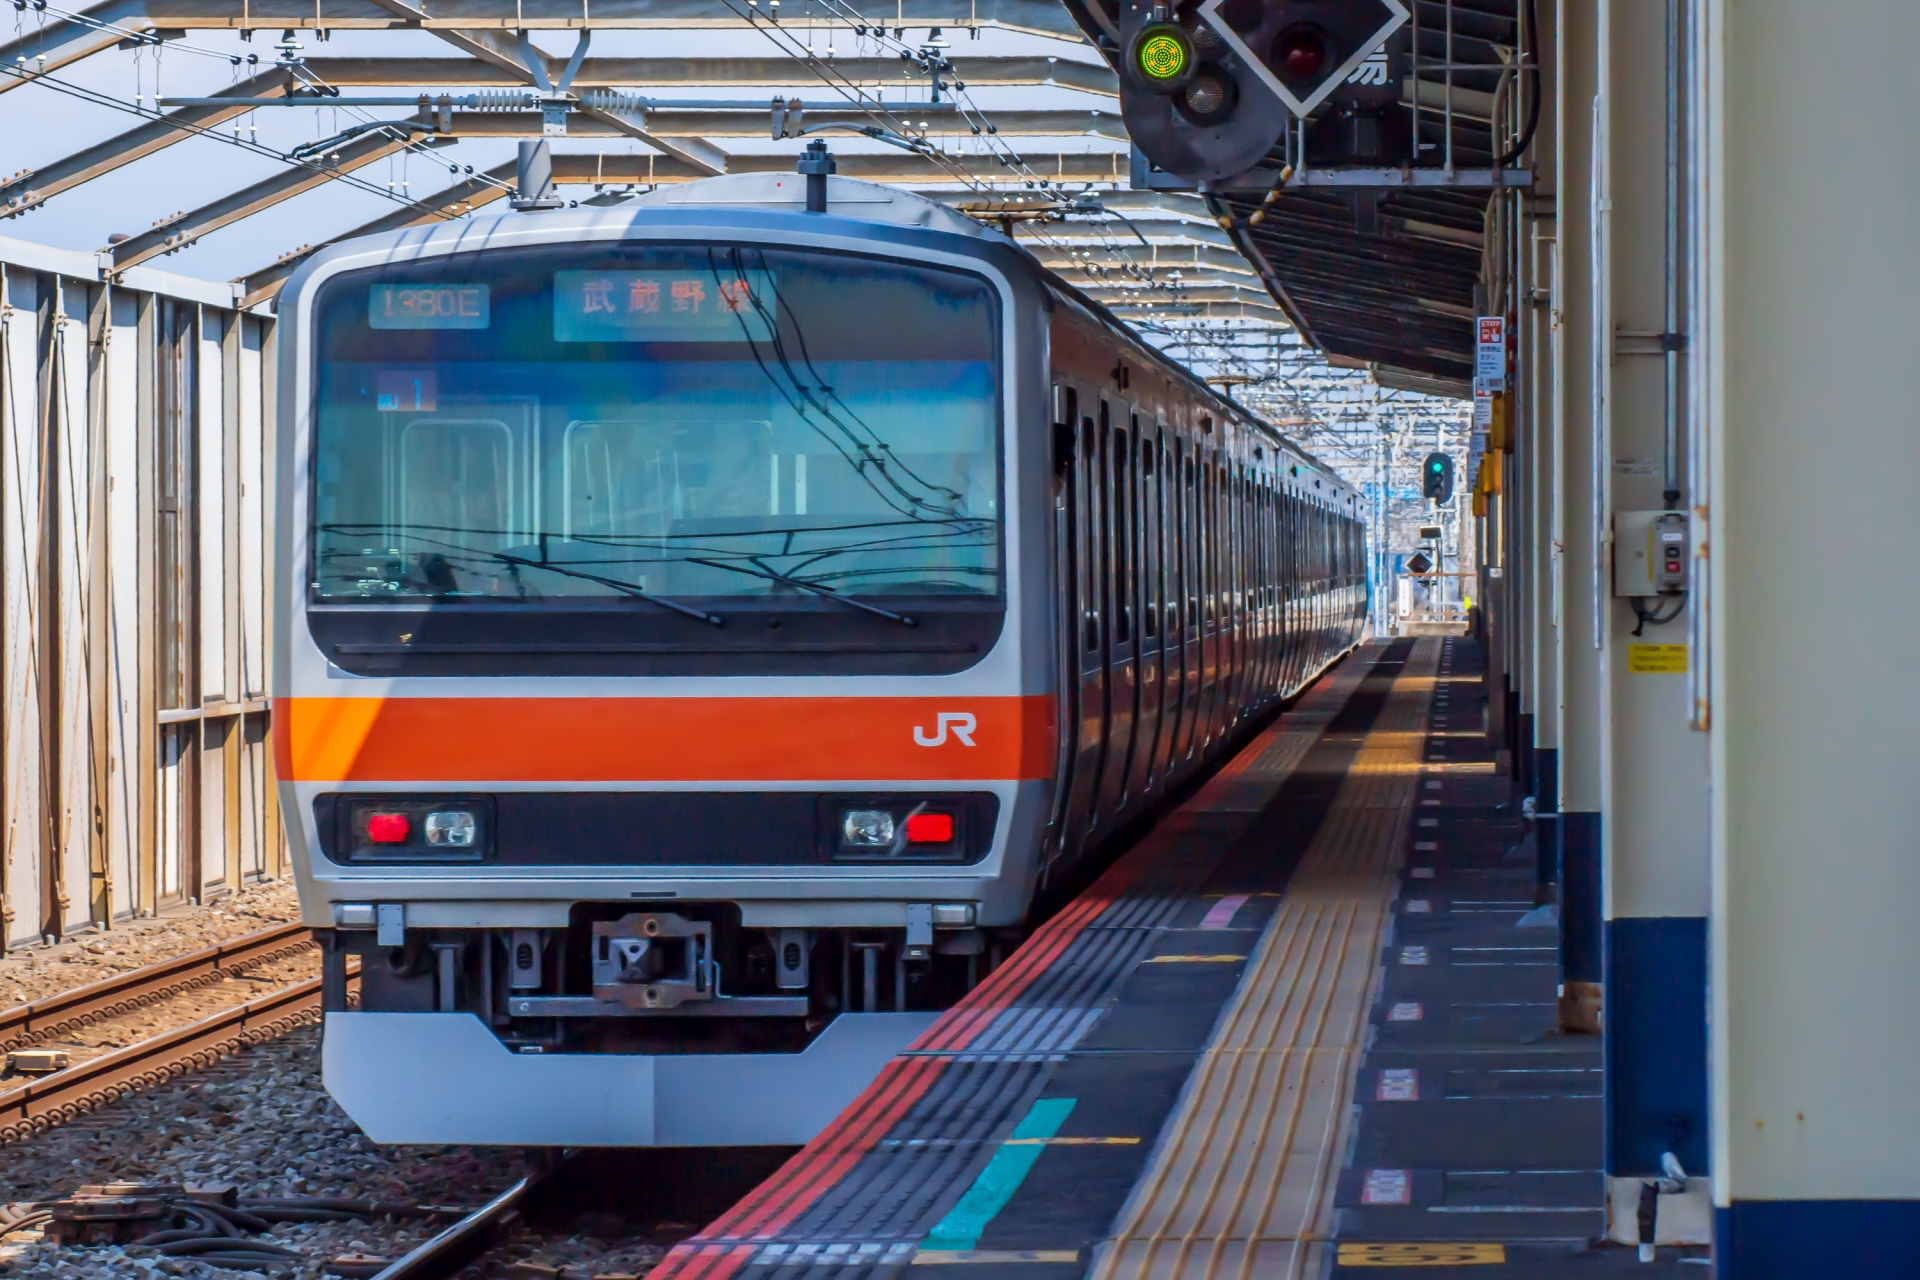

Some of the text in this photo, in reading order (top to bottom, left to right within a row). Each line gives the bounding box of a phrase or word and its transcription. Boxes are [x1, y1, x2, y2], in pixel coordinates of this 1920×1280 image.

[384, 290, 479, 316] 1380E
[582, 279, 751, 313] 武蔵野線
[913, 712, 976, 747] JR
